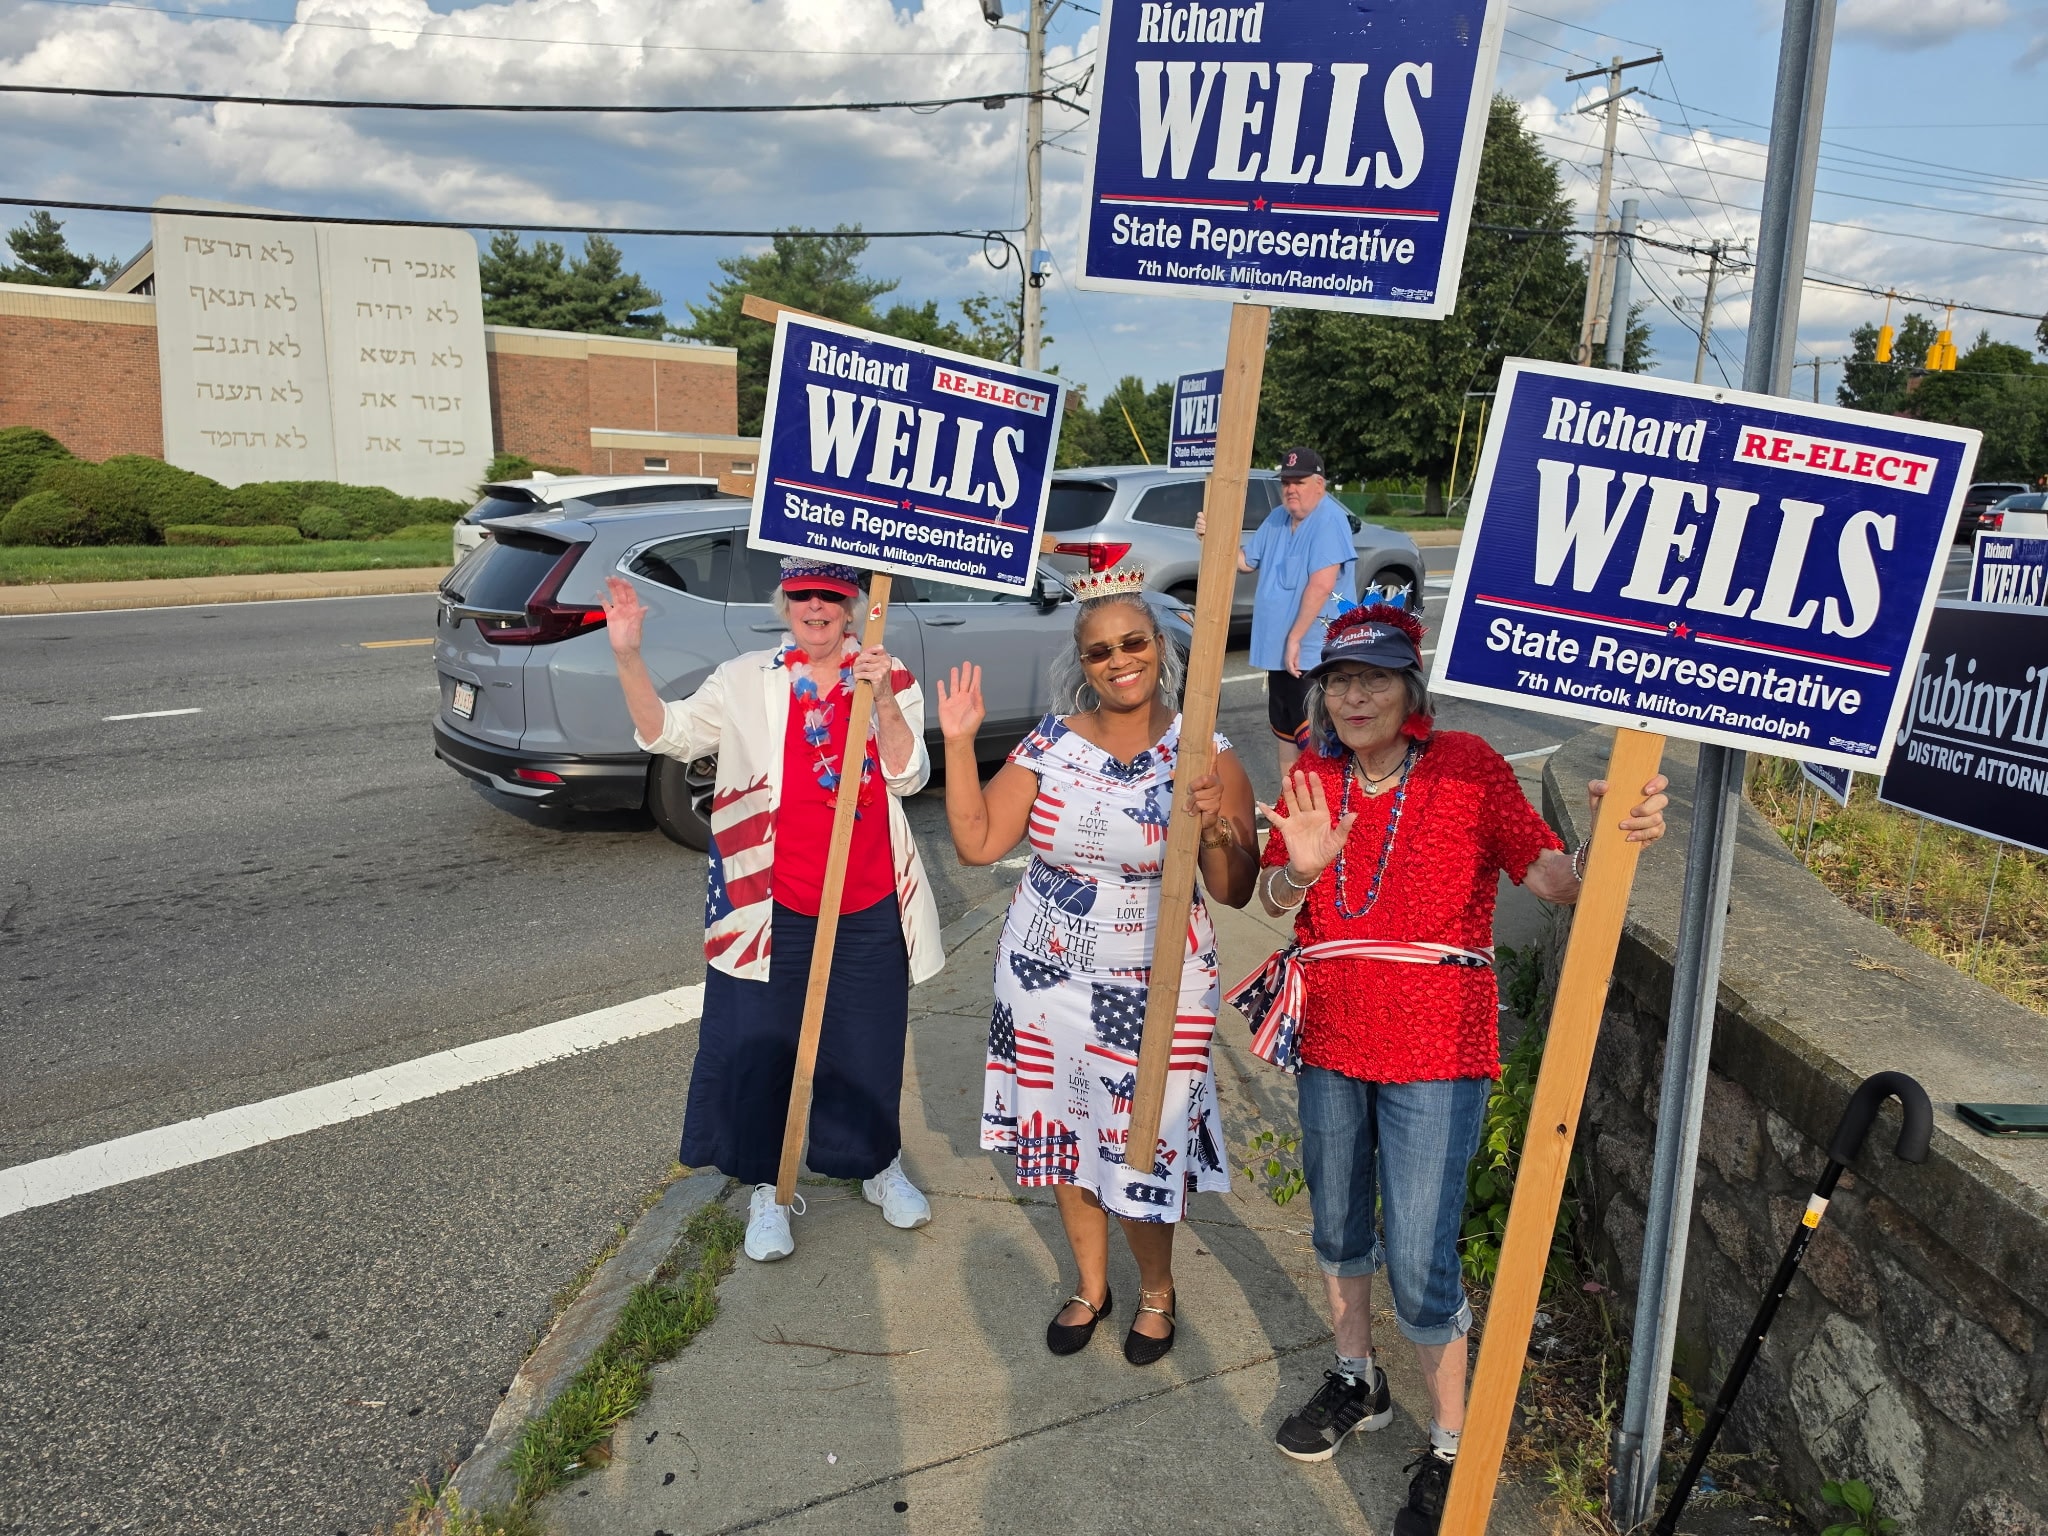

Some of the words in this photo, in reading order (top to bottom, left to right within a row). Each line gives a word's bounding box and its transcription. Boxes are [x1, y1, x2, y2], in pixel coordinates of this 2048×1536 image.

[1137, 2, 1264, 43] Richard
[1134, 60, 1433, 190] WELLS
[184, 235, 252, 260] תרצח
[1111, 213, 1182, 249] State
[1190, 218, 1415, 265] Representative
[260, 240, 294, 265] לא
[405, 260, 456, 279] אנכי
[1137, 259, 1162, 278] 7th
[1166, 261, 1226, 282] Norfolk
[1230, 265, 1374, 295] Milton/Randolph
[189, 285, 256, 311] תנאף
[263, 286, 298, 312] לא
[356, 302, 413, 320] יהיה
[426, 300, 459, 324] לא
[193, 334, 260, 355] תגנב
[267, 333, 302, 358] לא
[360, 346, 416, 366] תשא
[430, 346, 463, 368] לא
[807, 341, 910, 393] Richard
[937, 371, 1045, 412] RE-ELECT
[196, 382, 262, 401] תענה
[270, 380, 304, 404] לא
[359, 391, 397, 408] את
[411, 394, 461, 412] זכור
[1180, 394, 1222, 436] WEL
[200, 429, 267, 448] תחמד
[275, 426, 308, 449] לא
[365, 435, 401, 452] את
[418, 438, 466, 456] כבד
[806, 383, 1025, 510] WELLS
[1542, 397, 1707, 463] Richard
[1742, 433, 1929, 488] RE-ELECT
[783, 495, 846, 531] State
[851, 508, 1014, 559] Representative
[806, 532, 828, 547] 7th
[831, 536, 880, 557] Norfolk
[883, 545, 987, 576] Milton/Randolph
[1534, 458, 1897, 640] WELLS
[1984, 542, 2013, 560] Richard
[1981, 563, 2043, 606] WELLS
[1331, 628, 1387, 648] Randolph
[1486, 618, 1581, 665] State
[1589, 636, 1862, 715] Representative
[1516, 671, 1549, 693] 7th
[1554, 677, 1631, 709] Norfolk
[1636, 690, 1811, 742] Milton/Randolph
[1907, 739, 1975, 776] DISTRICT
[1078, 815, 1108, 832] LOVE
[1116, 907, 1145, 919] LOVE
[1069, 1074, 1090, 1090] LOVE
[1098, 1128, 1178, 1165] AMECA
